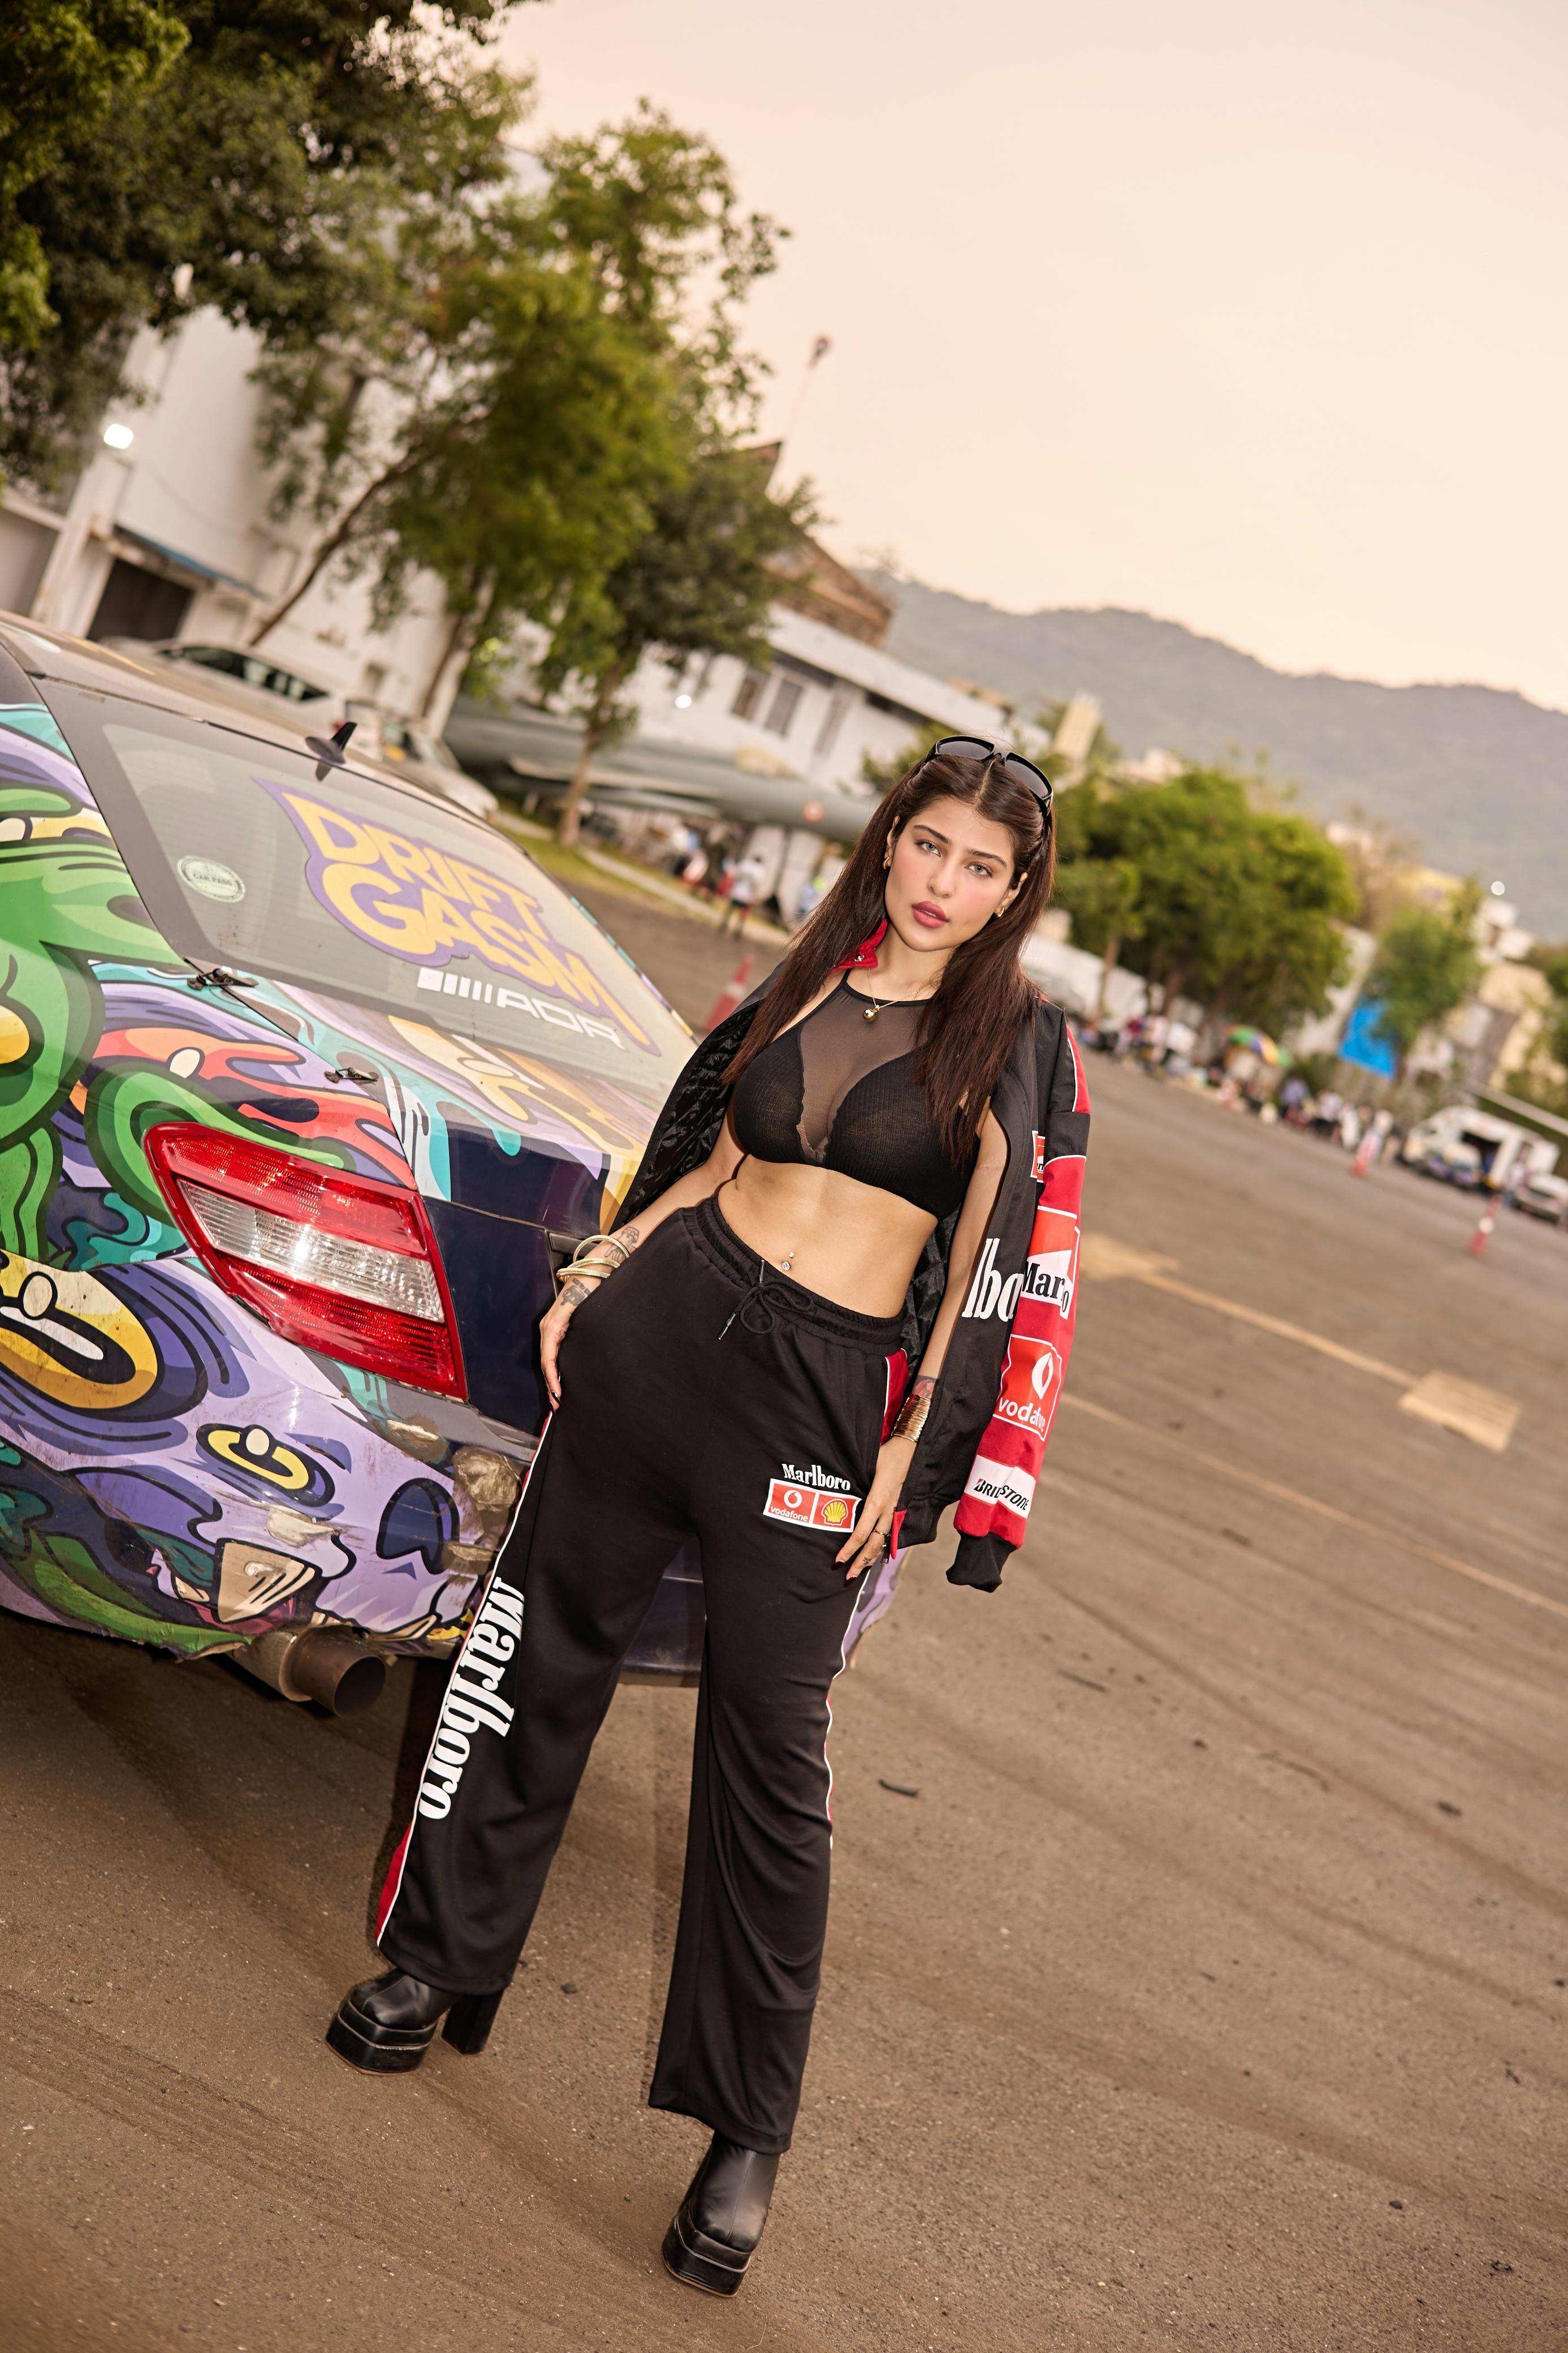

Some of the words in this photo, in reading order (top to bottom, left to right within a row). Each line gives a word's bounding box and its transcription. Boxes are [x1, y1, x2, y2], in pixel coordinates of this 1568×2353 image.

[282, 792, 550, 942] DRIFT
[322, 863, 651, 1046] GASM
[771, 1506, 809, 1523] vodafone
[781, 1463, 851, 1491] Marlboro
[418, 1576, 525, 1820] Marlboro
